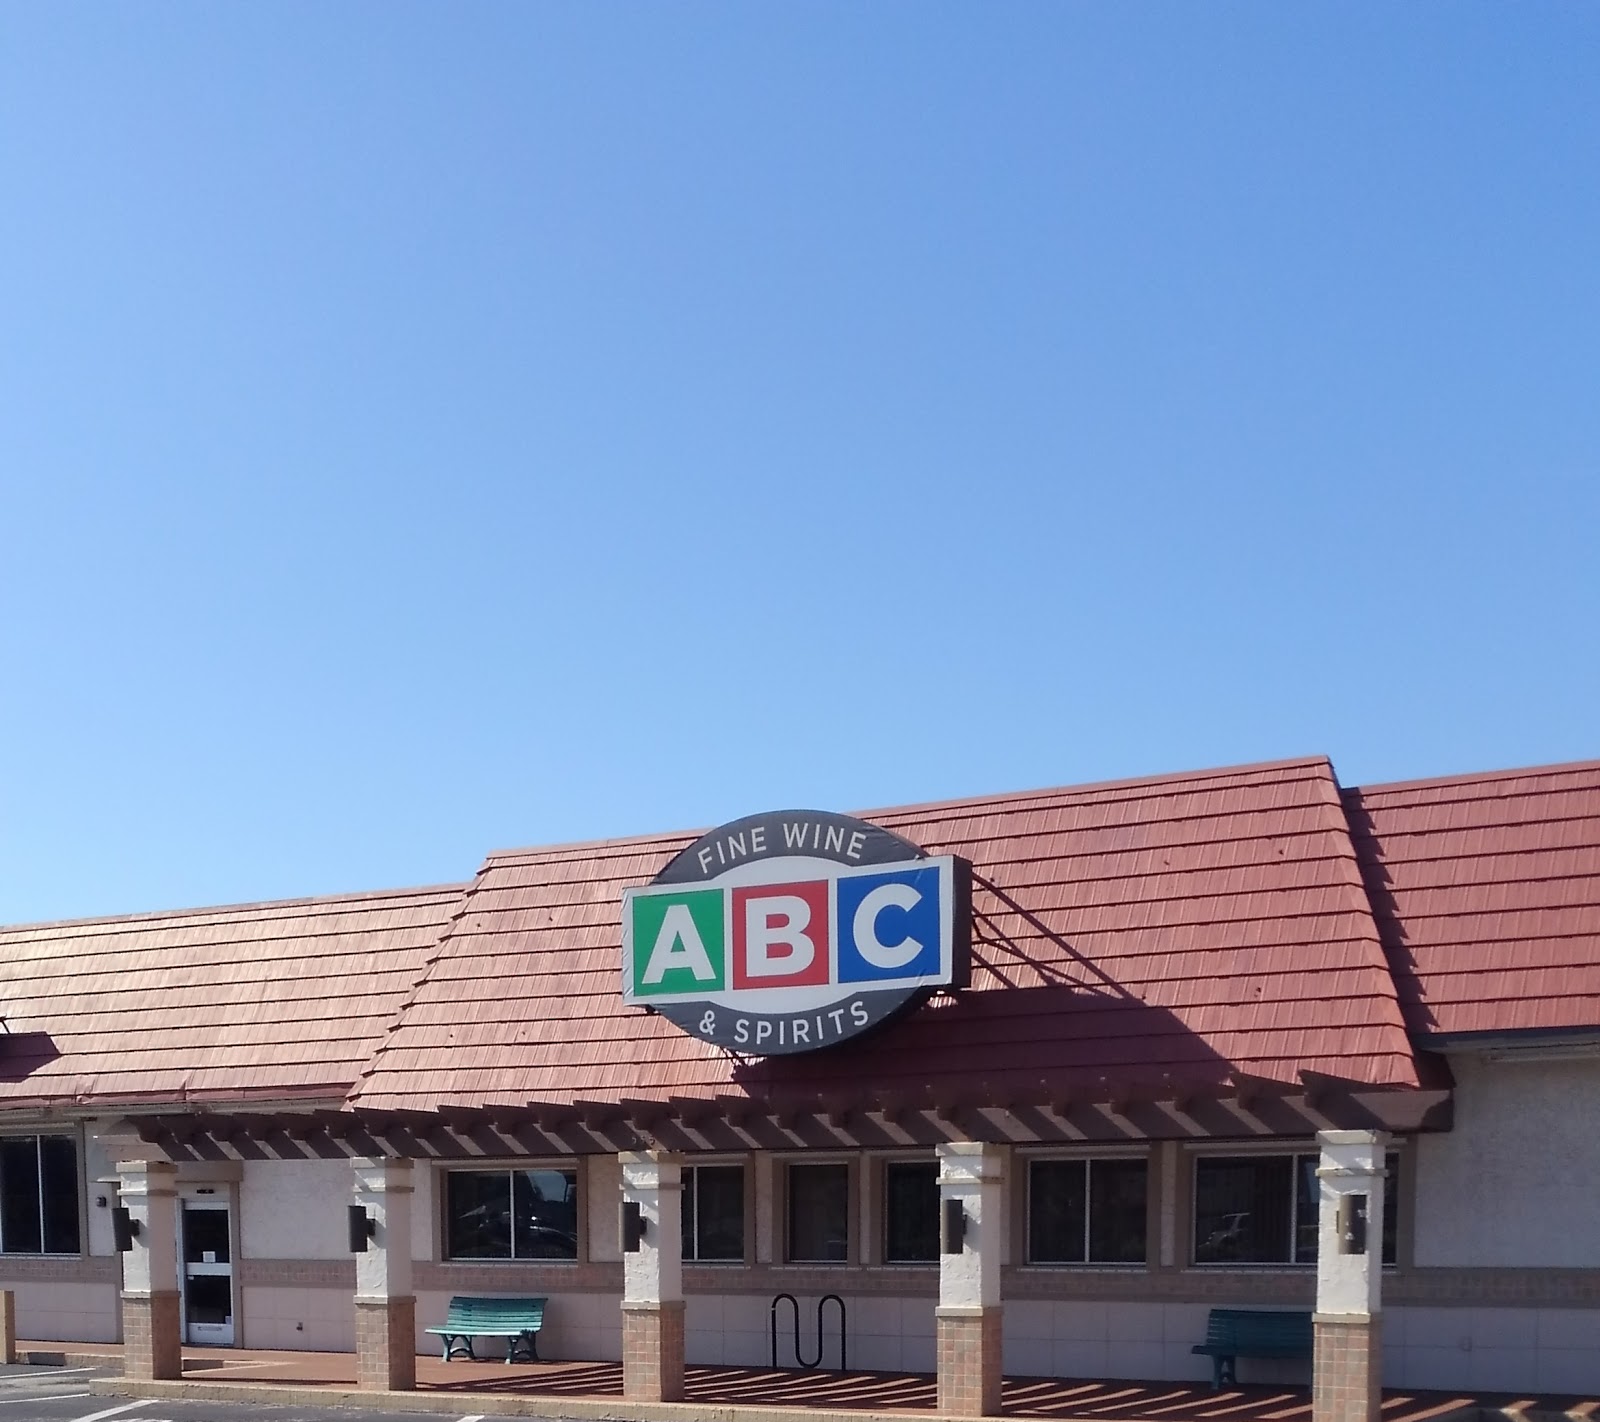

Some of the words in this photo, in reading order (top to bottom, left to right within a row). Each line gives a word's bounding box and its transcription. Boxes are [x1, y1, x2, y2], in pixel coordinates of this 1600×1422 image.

[697, 826, 767, 874] FINE
[783, 822, 867, 859] WINE
[641, 883, 924, 985] ABC
[699, 1009, 716, 1035] &
[733, 1000, 869, 1045] SPIRITS
